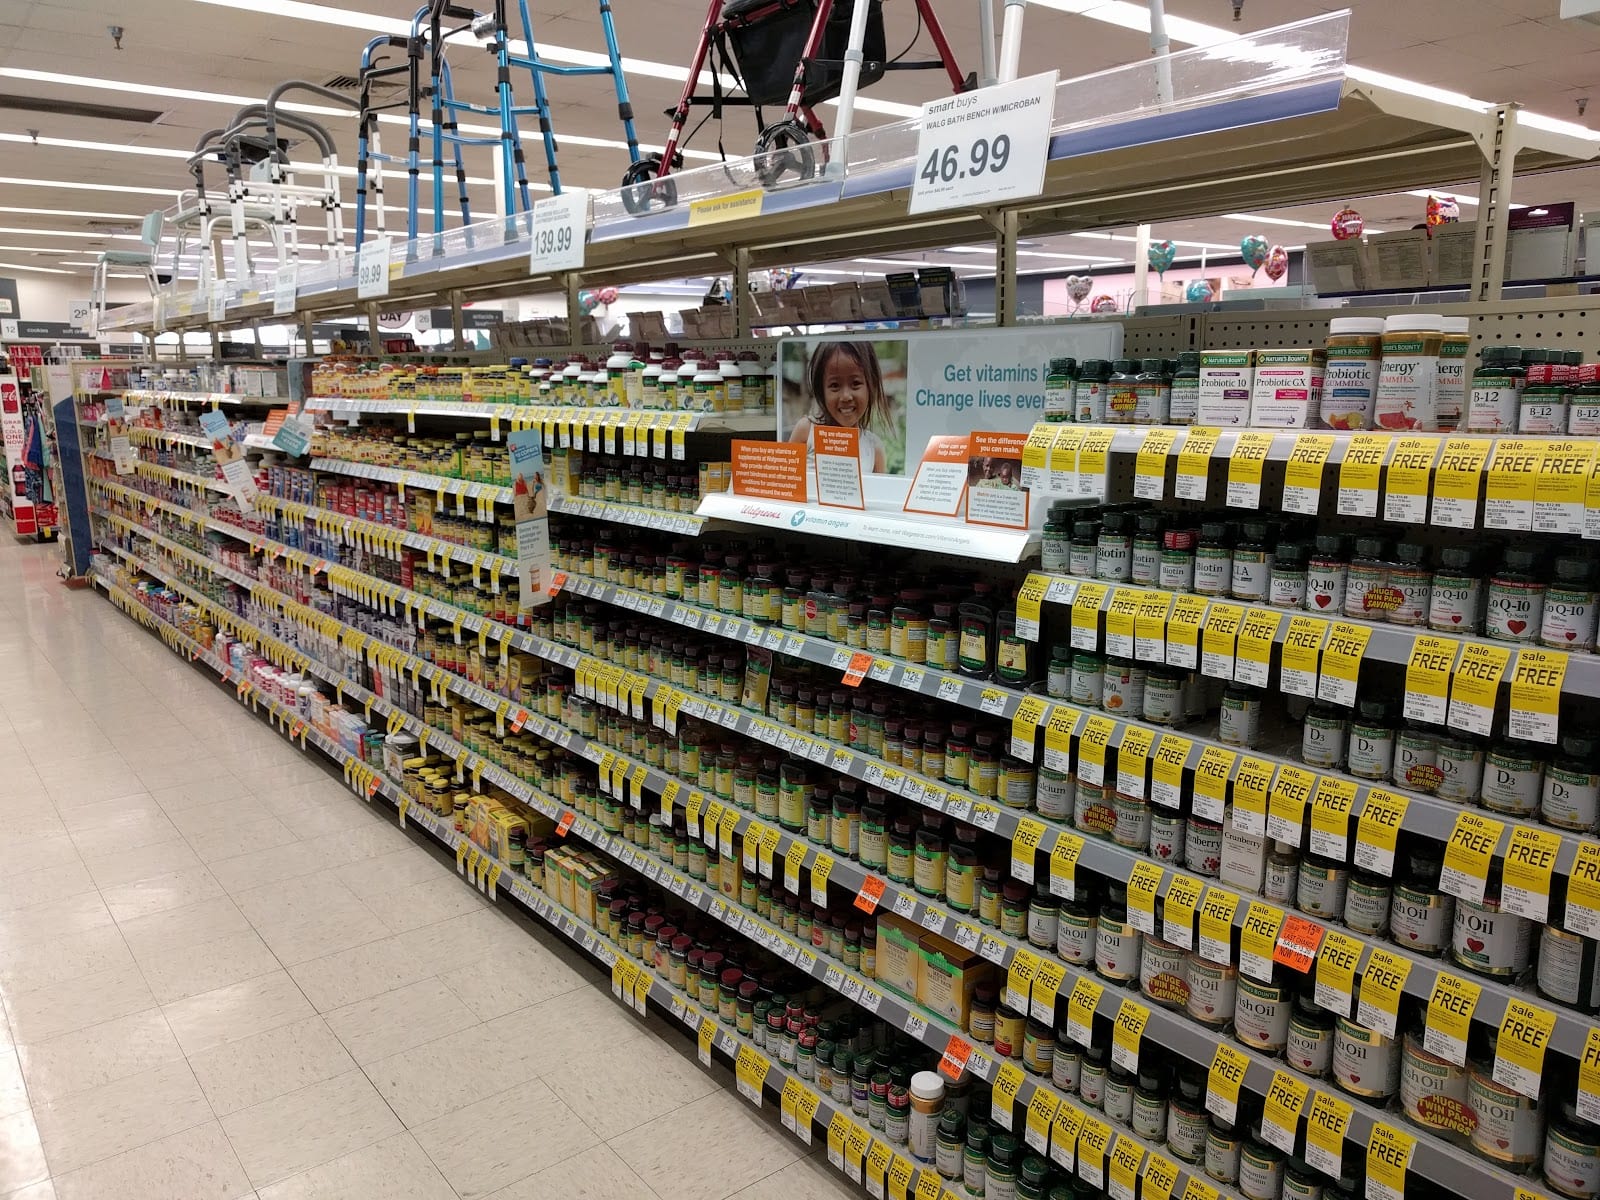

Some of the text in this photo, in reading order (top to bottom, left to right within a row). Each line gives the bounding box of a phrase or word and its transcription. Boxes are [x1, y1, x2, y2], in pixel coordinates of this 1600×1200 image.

[929, 96, 977, 114] smart buys
[927, 97, 1040, 130] WALG BATH BENCH W/MICROBAN
[921, 134, 1010, 184] 46.99
[535, 226, 572, 255] 139.99
[360, 264, 381, 285] 99.99
[380, 312, 402, 321] DAY
[1349, 347, 1370, 356] BOUNTY
[1228, 356, 1247, 364] BOUNTY
[1288, 355, 1308, 363] BOUNTY
[944, 363, 1038, 382] Get vitamins
[1201, 378, 1247, 388] Probiotic 10
[1256, 377, 1306, 387] Probiotic GX
[916, 389, 973, 411] Change
[979, 390, 1011, 407] lives
[1474, 391, 1499, 402] B-12
[1529, 407, 1552, 417] B-12
[1149, 429, 1164, 438] sale
[1191, 428, 1206, 437] sale
[1353, 436, 1372, 444] sale
[1500, 442, 1523, 451] sale
[740, 505, 781, 519] Walgreens
[805, 516, 849, 529] vitamin angels
[1196, 563, 1223, 572] Biotin
[1311, 579, 1335, 591] Q-10
[1383, 594, 1403, 604] PACK
[1442, 589, 1468, 601] Q-10
[1213, 606, 1229, 614] sale
[1499, 598, 1531, 612] Q-10
[1555, 606, 1584, 617] Q-10
[1418, 638, 1439, 648] sale
[1522, 652, 1546, 662] sale
[1206, 747, 1221, 756] sale
[1461, 814, 1483, 828] sale
[1224, 831, 1262, 849] Cranberry
[1253, 904, 1268, 916] sale
[1407, 906, 1428, 920] Oil
[1468, 915, 1493, 935] Oil
[1440, 975, 1461, 990] sale
[1255, 1004, 1275, 1017] Oil
[1511, 1004, 1534, 1020] sale
[1432, 1094, 1462, 1112] HUGE
[1418, 1098, 1476, 1127] TWIN PACK
[1424, 1112, 1470, 1136] SAVINGS
[1376, 1126, 1394, 1141] sale
